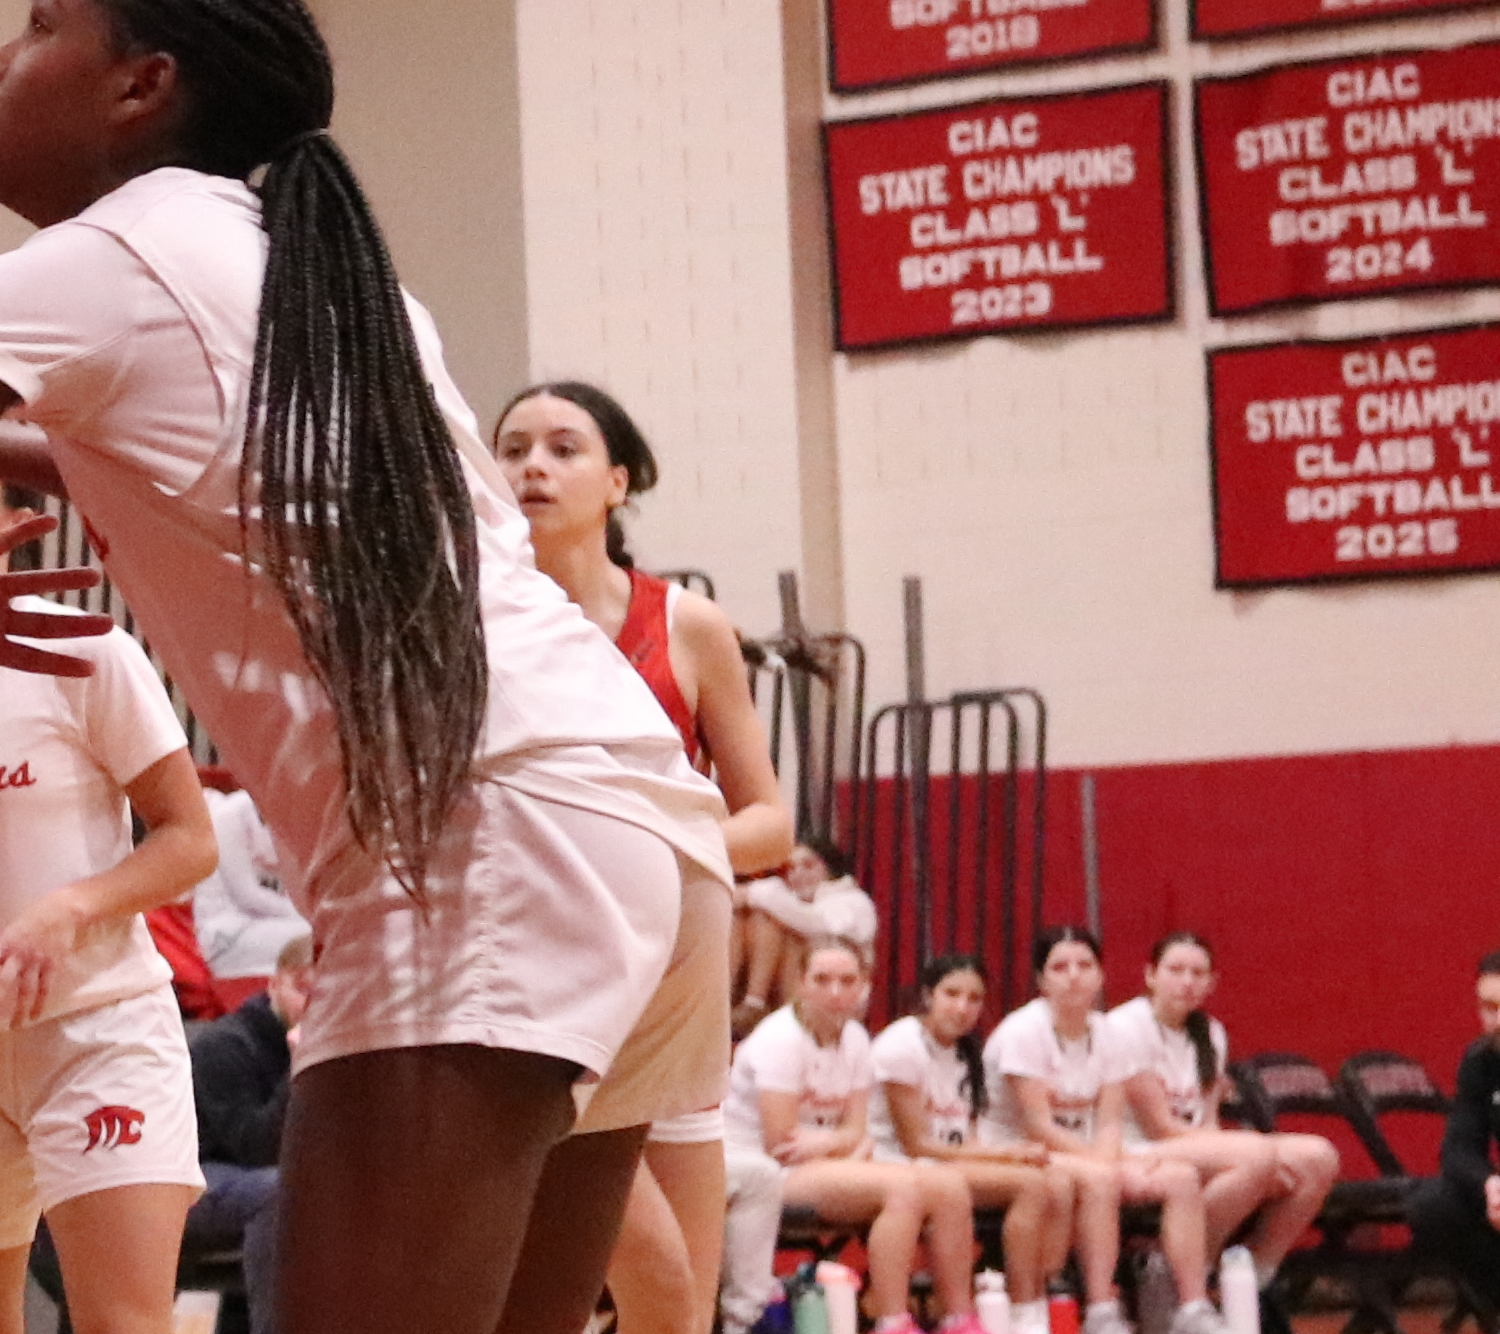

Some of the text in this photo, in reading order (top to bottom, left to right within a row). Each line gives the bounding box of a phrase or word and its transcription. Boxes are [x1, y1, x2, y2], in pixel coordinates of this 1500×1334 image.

[1327, 65, 1420, 108] CIAC
[948, 114, 1039, 155] CIAC
[1236, 118, 1330, 171] STATE
[859, 146, 1136, 215] STATE CHAMPIONS
[1278, 154, 1417, 202] CLASS
[909, 200, 1038, 248] CLASS
[1268, 194, 1487, 246] SOFTBALL
[898, 240, 1105, 291] SOFTBALL
[1325, 238, 1435, 282] 2024
[950, 283, 1053, 326] 2023
[1341, 346, 1438, 388] CIAC
[1246, 379, 1500, 443] STATE CHAMPIO
[1294, 435, 1436, 479] CLASS
[1285, 472, 1500, 523] SOFTBALL
[1335, 519, 1459, 561] 2025
